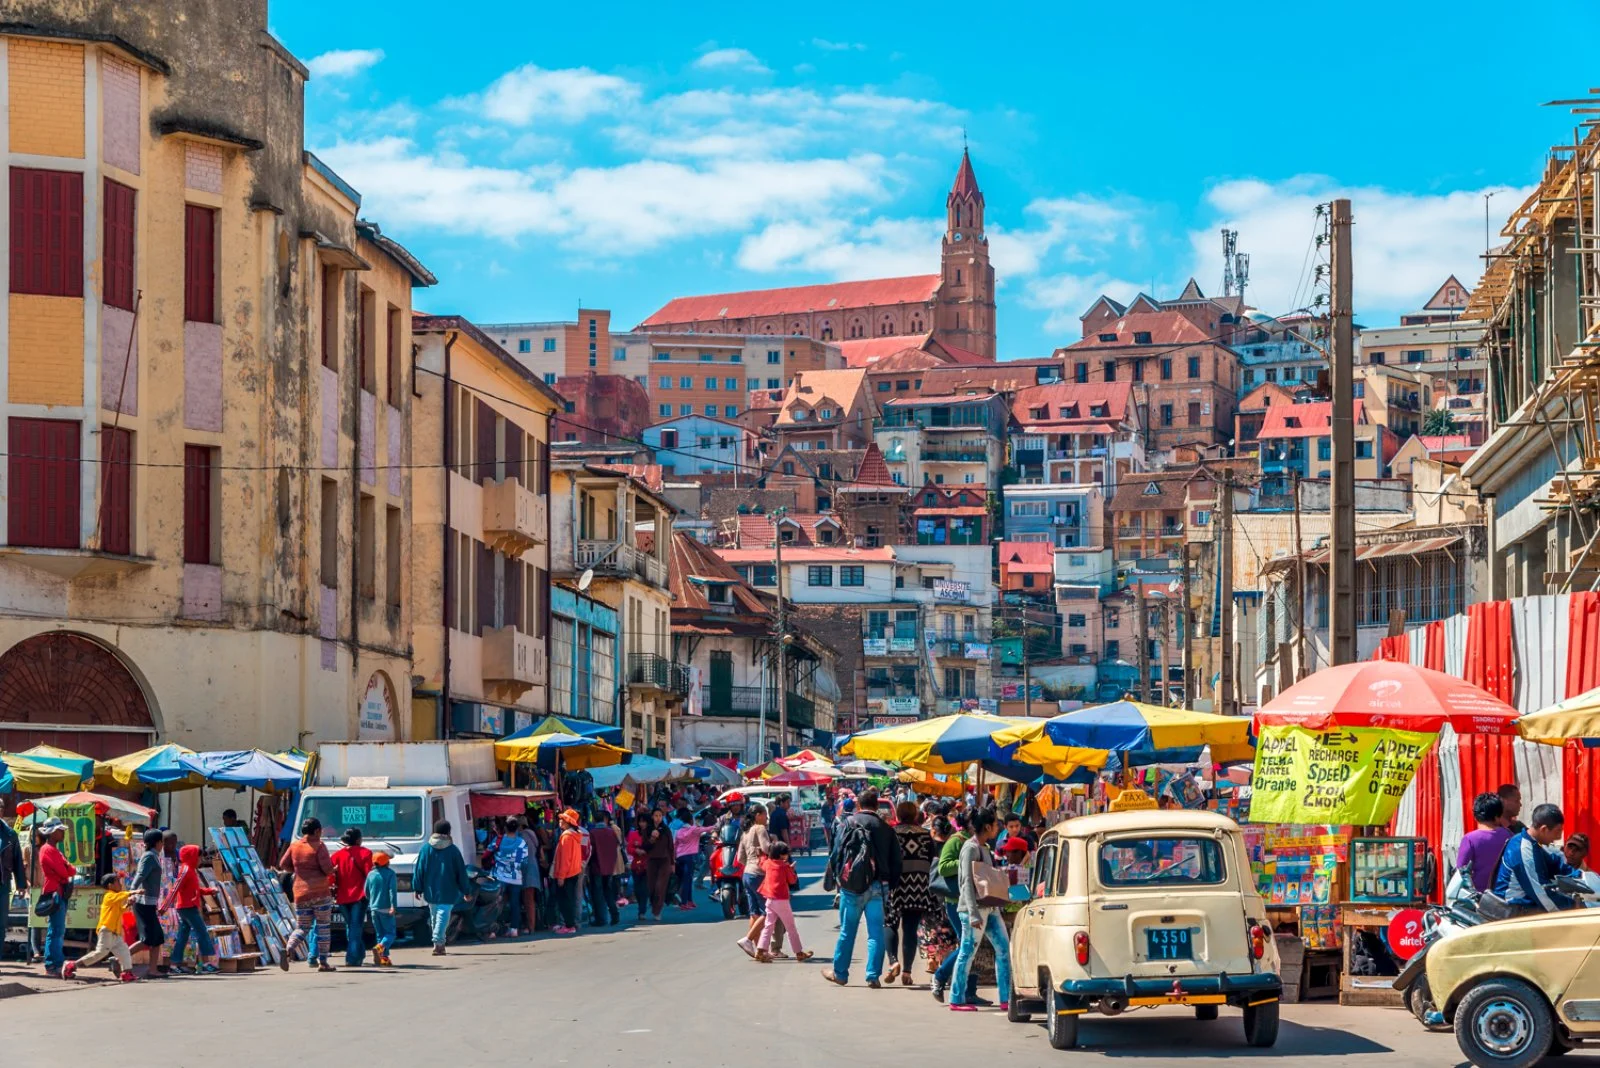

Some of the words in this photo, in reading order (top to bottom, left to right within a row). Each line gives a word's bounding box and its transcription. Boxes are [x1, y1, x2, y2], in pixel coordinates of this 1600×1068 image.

[934, 580, 971, 590] UNIVERSITE
[1260, 737, 1297, 753] APPEL
[1373, 739, 1422, 760] APPEL
[1261, 756, 1293, 766] TELMA
[1308, 749, 1359, 763] RECHARGE
[1374, 759, 1415, 772] TELMA
[1371, 771, 1409, 782] AIRTEL
[1254, 777, 1297, 792] Orange
[1123, 793, 1145, 802] TAXI
[344, 807, 366, 815] MISY
[344, 814, 366, 822] VARY
[1152, 931, 1187, 944] 4350
[1400, 936, 1422, 946] airtel
[1161, 945, 1177, 958] TV
